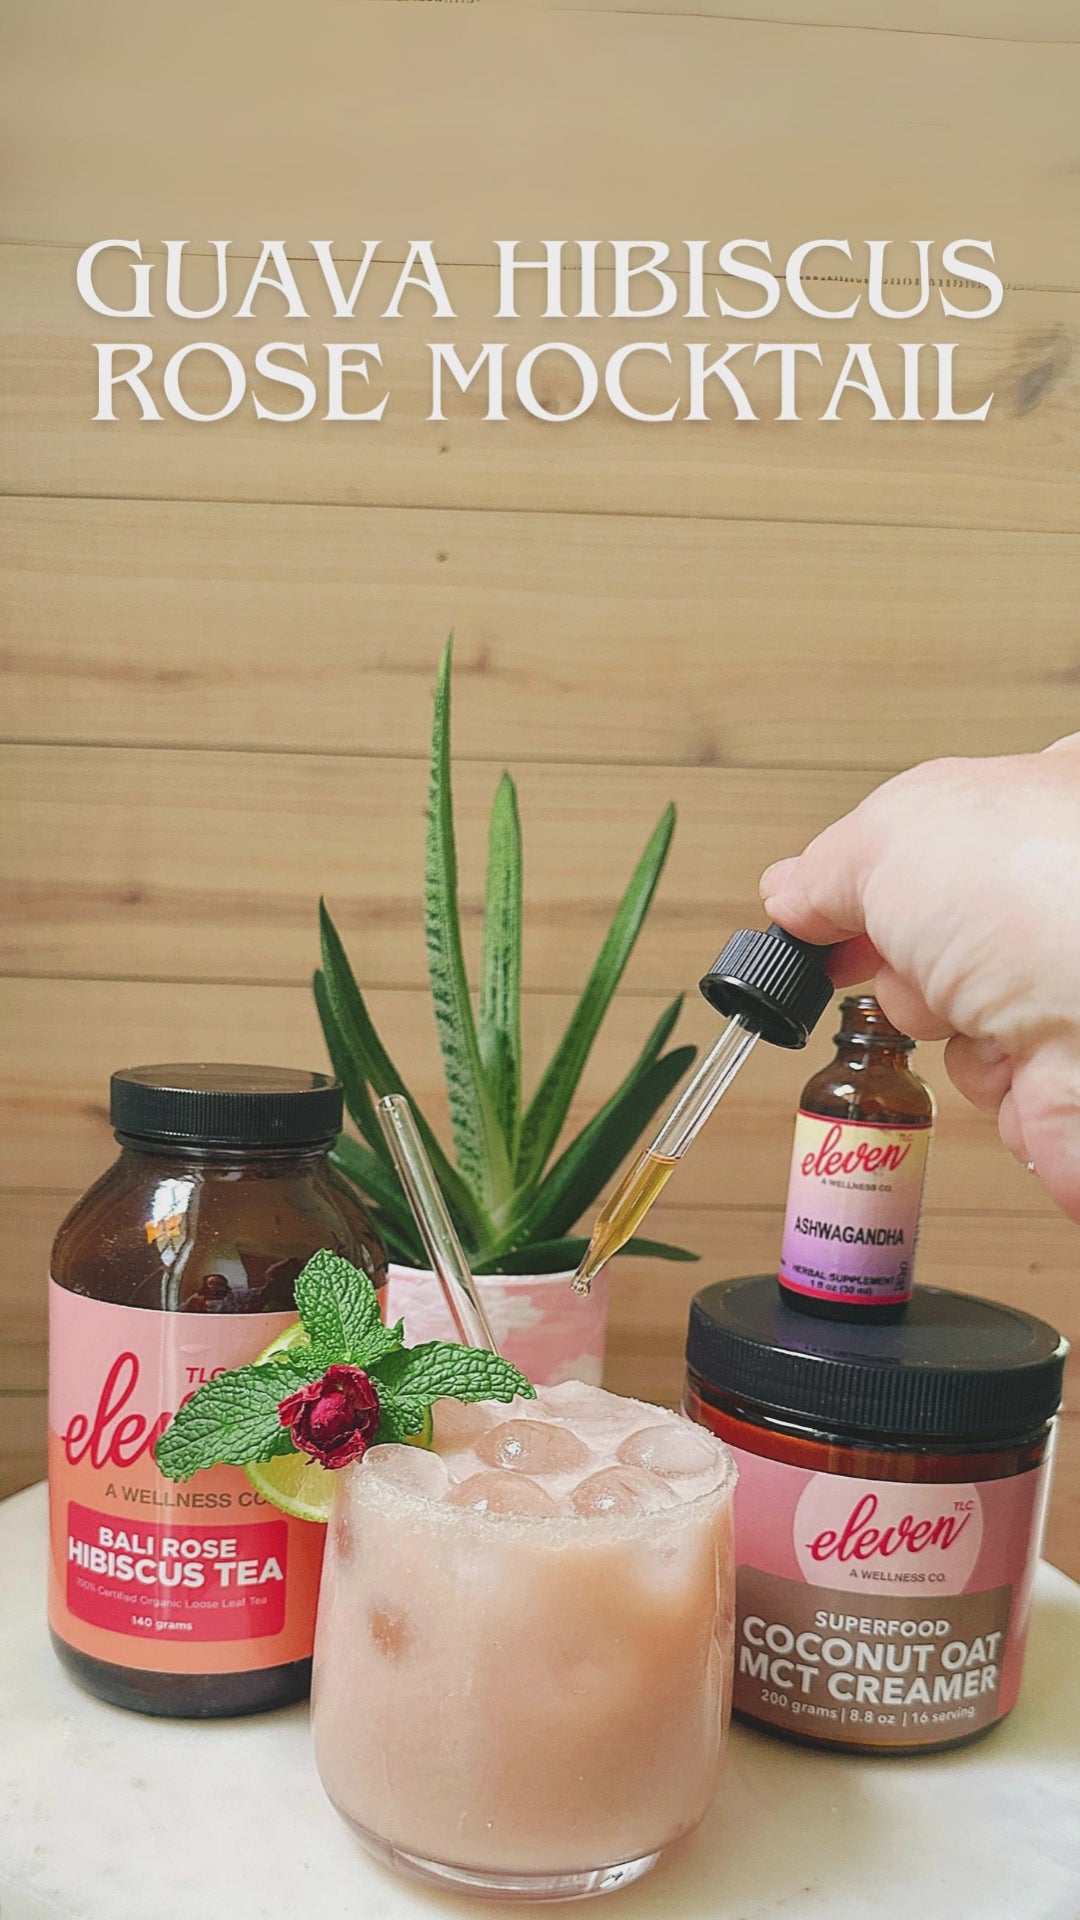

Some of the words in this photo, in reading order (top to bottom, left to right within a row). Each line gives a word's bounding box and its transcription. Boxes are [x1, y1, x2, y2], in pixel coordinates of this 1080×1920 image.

[801, 1123, 912, 1177] eleven
[829, 1179, 877, 1192] WELLNESS
[795, 1216, 904, 1246] ASHWAGANDHA
[825, 1284, 838, 1292] oz
[829, 1273, 895, 1286] SUPPLEMENT
[105, 1483, 117, 1498] A
[121, 1485, 232, 1508] WELLNESS
[805, 1493, 971, 1562] eleven
[100, 1526, 155, 1555] BALI
[161, 1537, 237, 1558] ROSE
[68, 1536, 205, 1588] HIBISCUS
[213, 1556, 284, 1587] TEA
[849, 1568, 859, 1578] A
[861, 1570, 926, 1583] WELLNESS
[99, 1586, 138, 1604] Certified
[140, 1594, 182, 1609] Organic
[185, 1599, 219, 1609] Loose
[221, 1597, 247, 1609] Leaf
[250, 1596, 268, 1605] Tea
[131, 1614, 153, 1628] 140
[155, 1619, 193, 1631] grams
[814, 1610, 950, 1637] SUPERFOOD
[742, 1615, 935, 1673] COCONUT
[940, 1631, 1001, 1670] OAT
[739, 1646, 819, 1694] MCT
[827, 1664, 998, 1706] CREAMER
[760, 1688, 788, 1708] 200
[791, 1701, 838, 1719] grams
[849, 1709, 874, 1723] 8.8
[877, 1714, 896, 1725] oz
[911, 1710, 929, 1724] 16
[932, 1705, 976, 1723] serving
